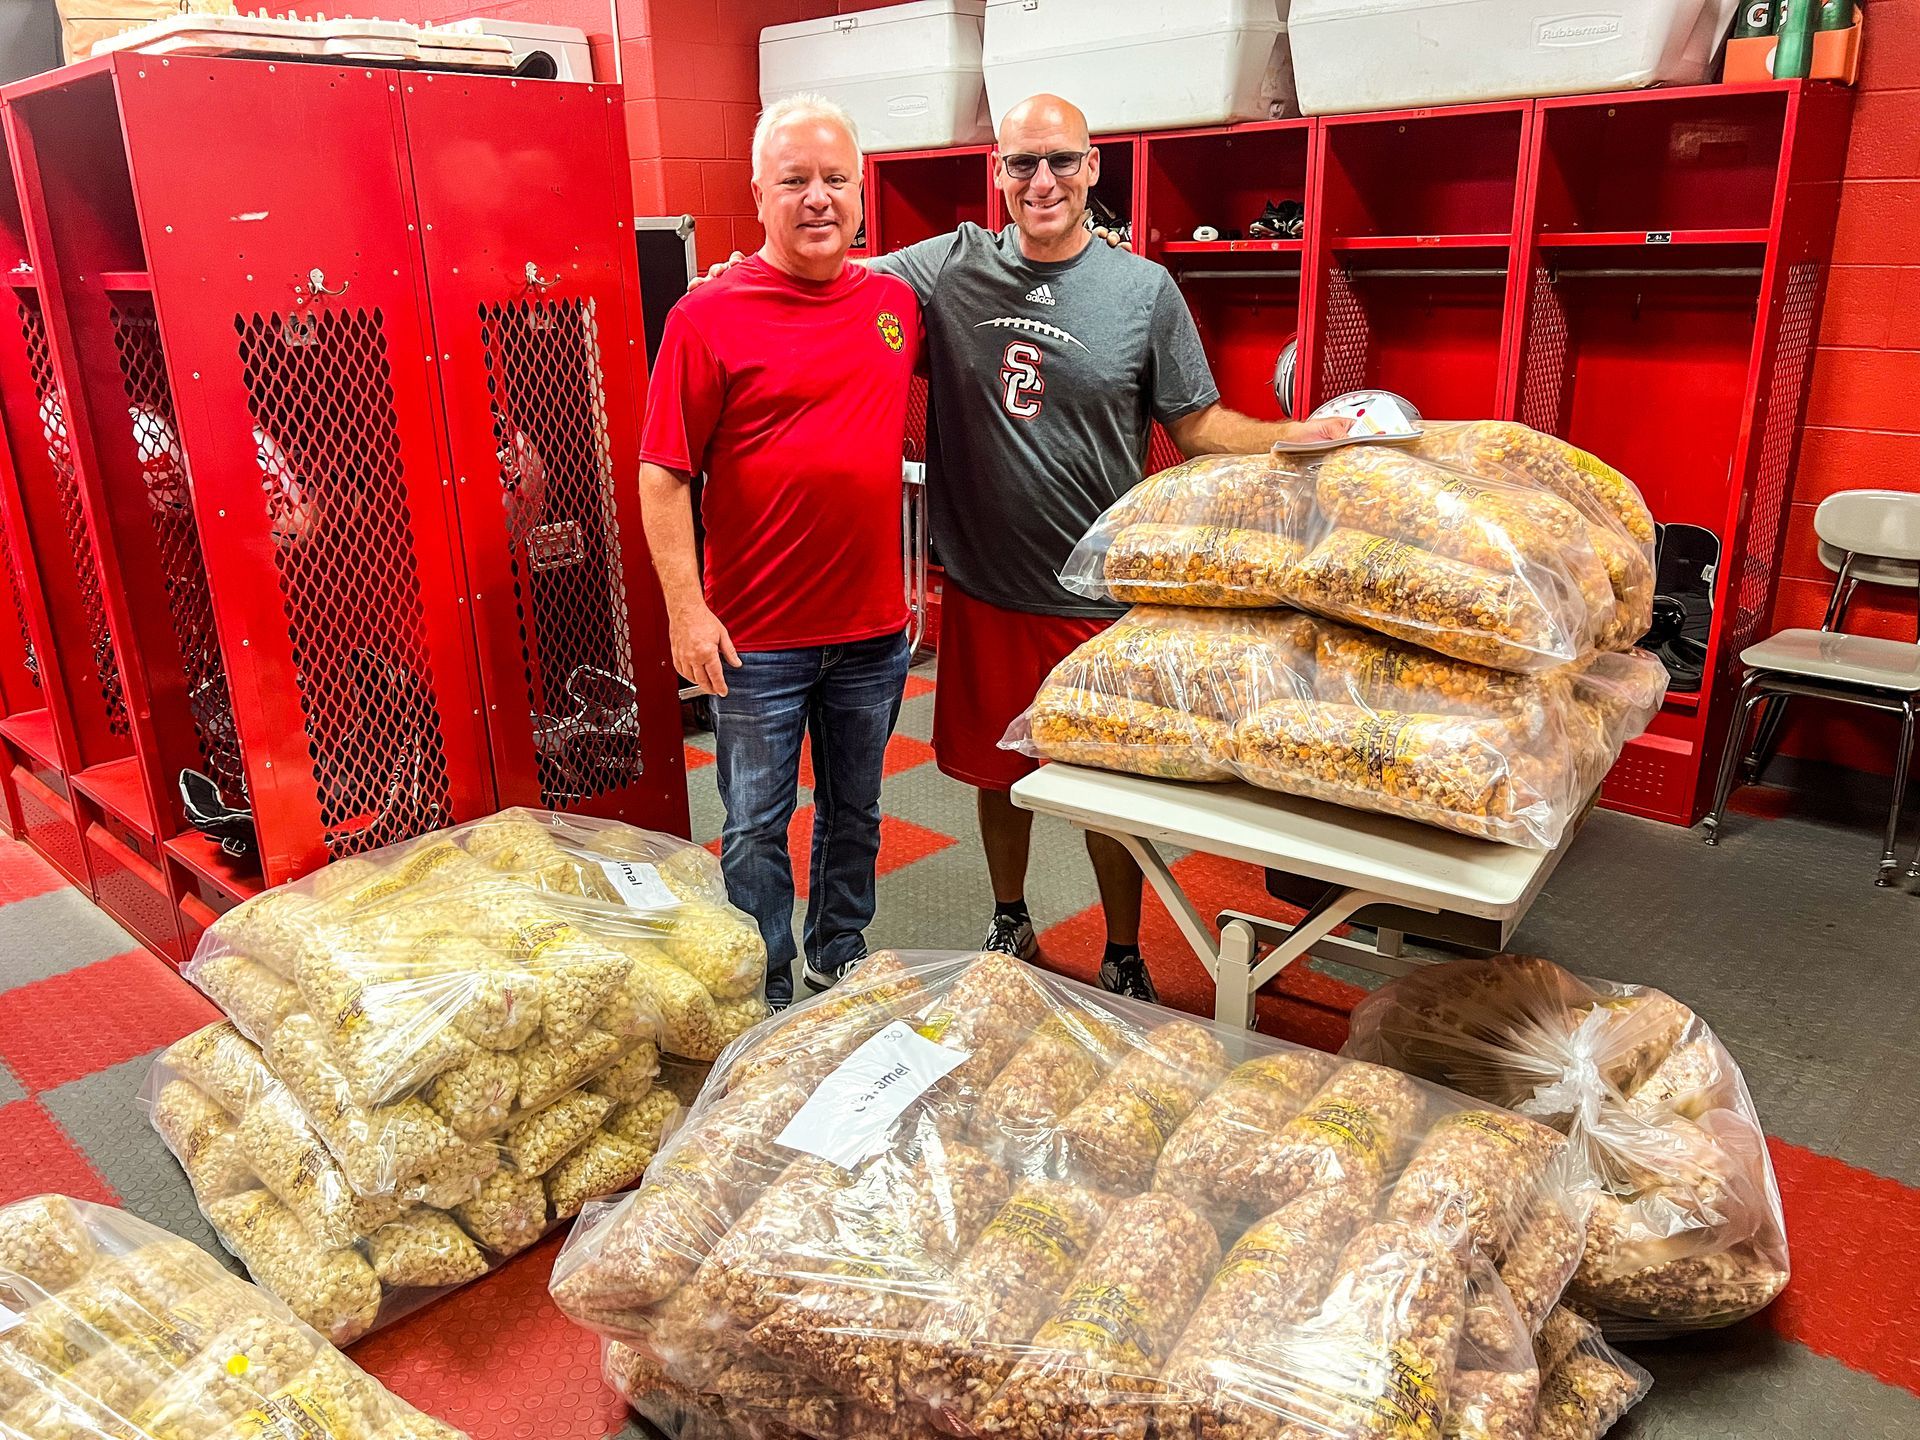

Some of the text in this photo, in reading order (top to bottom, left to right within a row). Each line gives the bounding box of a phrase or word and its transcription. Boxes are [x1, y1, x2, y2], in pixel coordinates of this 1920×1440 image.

[1746, 2, 1769, 28] G
[1542, 22, 1619, 39] Rubbermaid
[1025, 293, 1056, 306] adidas
[616, 861, 643, 886] inal
